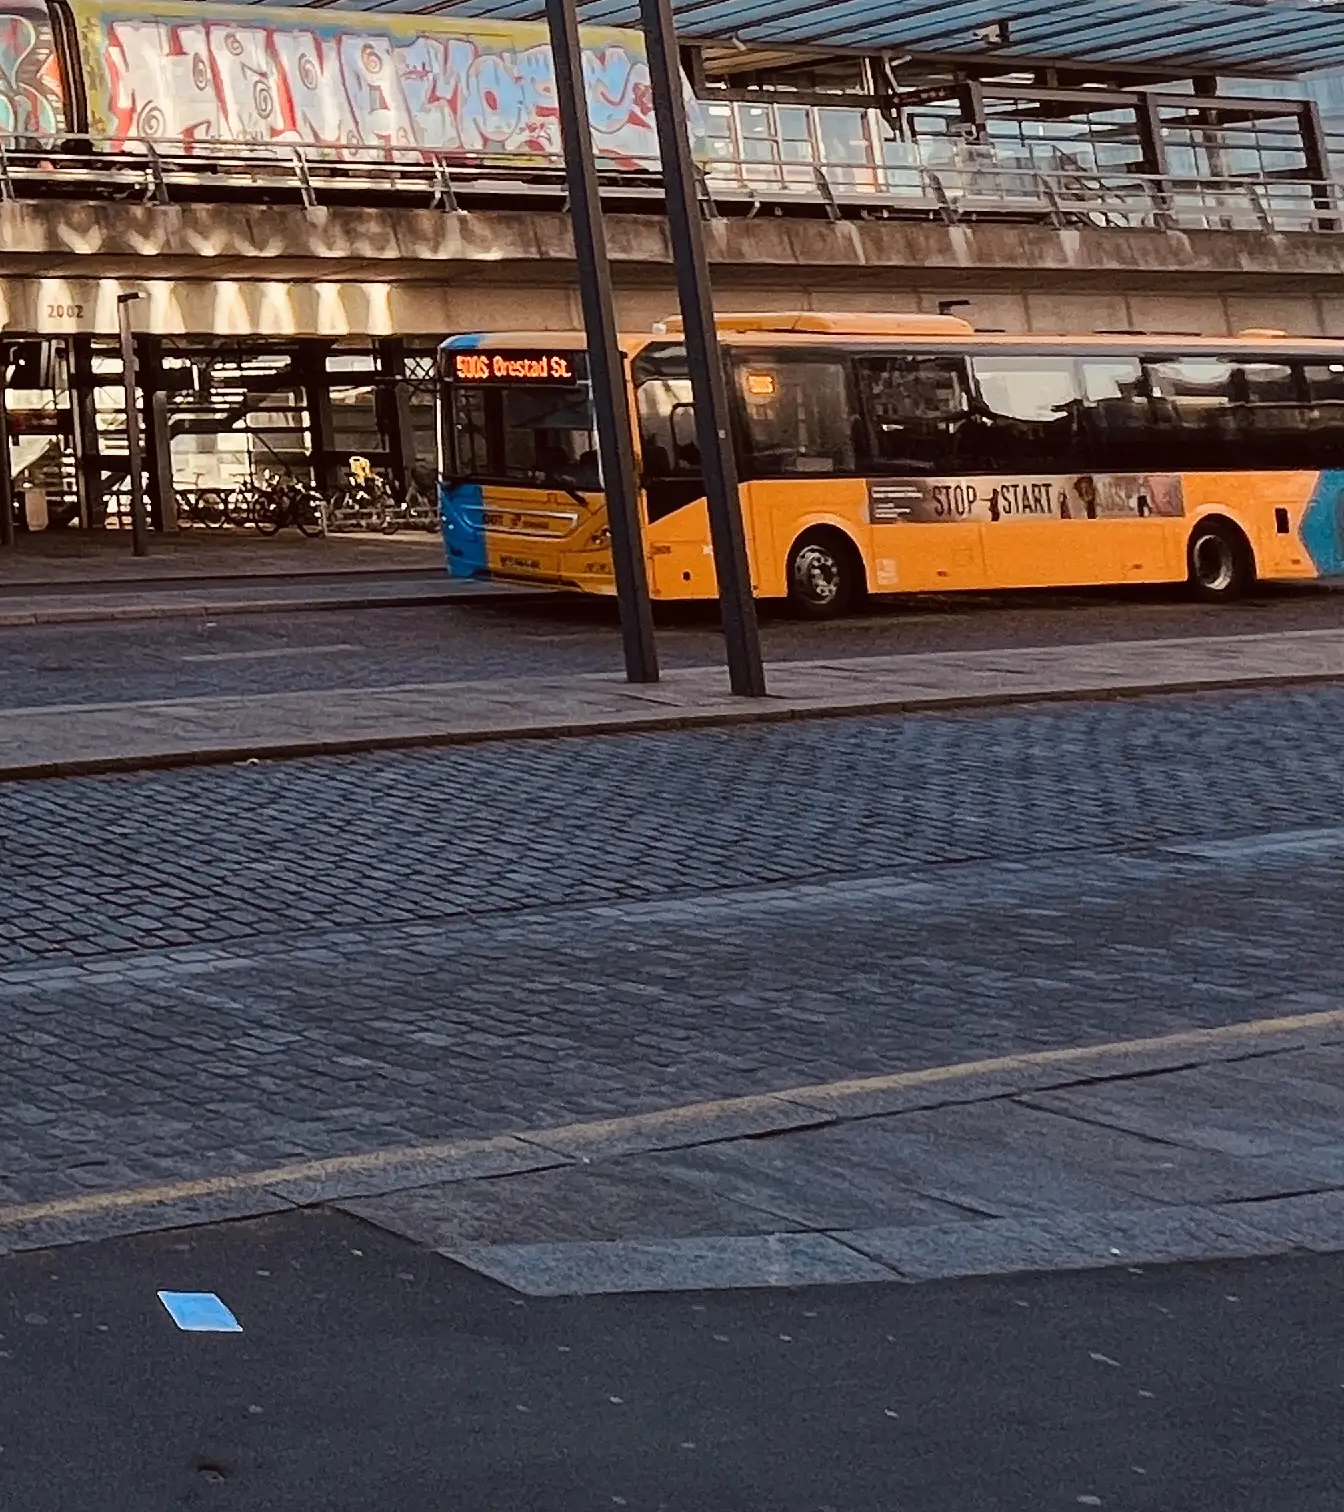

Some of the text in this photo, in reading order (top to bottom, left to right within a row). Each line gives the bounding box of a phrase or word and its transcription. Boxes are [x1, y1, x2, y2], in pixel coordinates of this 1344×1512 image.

[47, 304, 85, 318] 2002
[931, 484, 978, 517] STOP
[999, 482, 1054, 515] START
